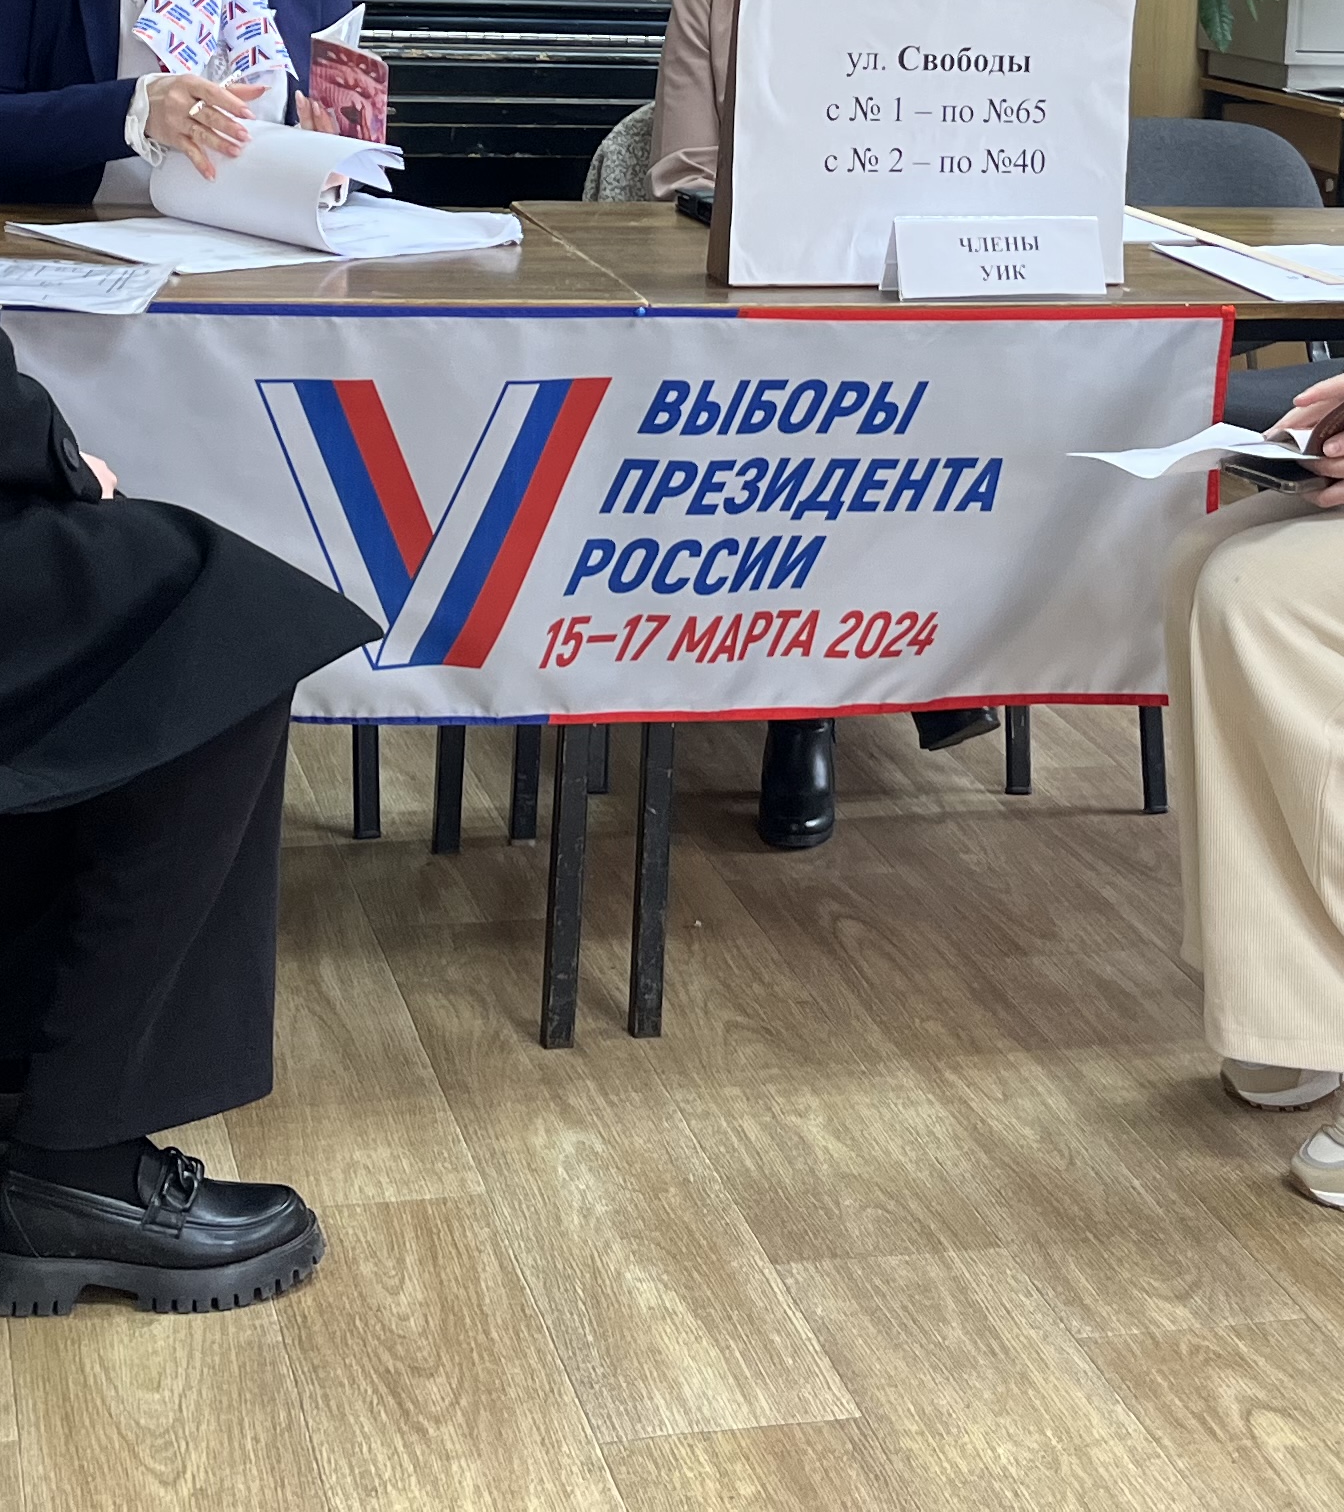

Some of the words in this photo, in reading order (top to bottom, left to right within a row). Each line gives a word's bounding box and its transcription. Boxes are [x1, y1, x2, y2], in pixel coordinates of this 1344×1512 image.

[846, 50, 887, 77] ул.
[897, 45, 1031, 75] Свободы
[826, 102, 840, 122] с
[848, 96, 881, 123] №
[893, 97, 903, 123] 1
[941, 104, 975, 123] по
[982, 97, 1047, 124] №65
[824, 154, 838, 173] с
[846, 147, 879, 173] №
[888, 147, 904, 173] 2
[939, 155, 972, 174] по
[980, 148, 1046, 174] №40
[959, 235, 1039, 253] ЧЛЕНЫ
[979, 264, 1026, 282] УИК
[637, 379, 929, 437] ВЫБОРЫ
[599, 456, 1003, 521] ПРЕЗИДЕНТА
[563, 534, 827, 597] РОССИИ
[666, 609, 821, 664] МАРТА
[823, 609, 939, 659] 2024
